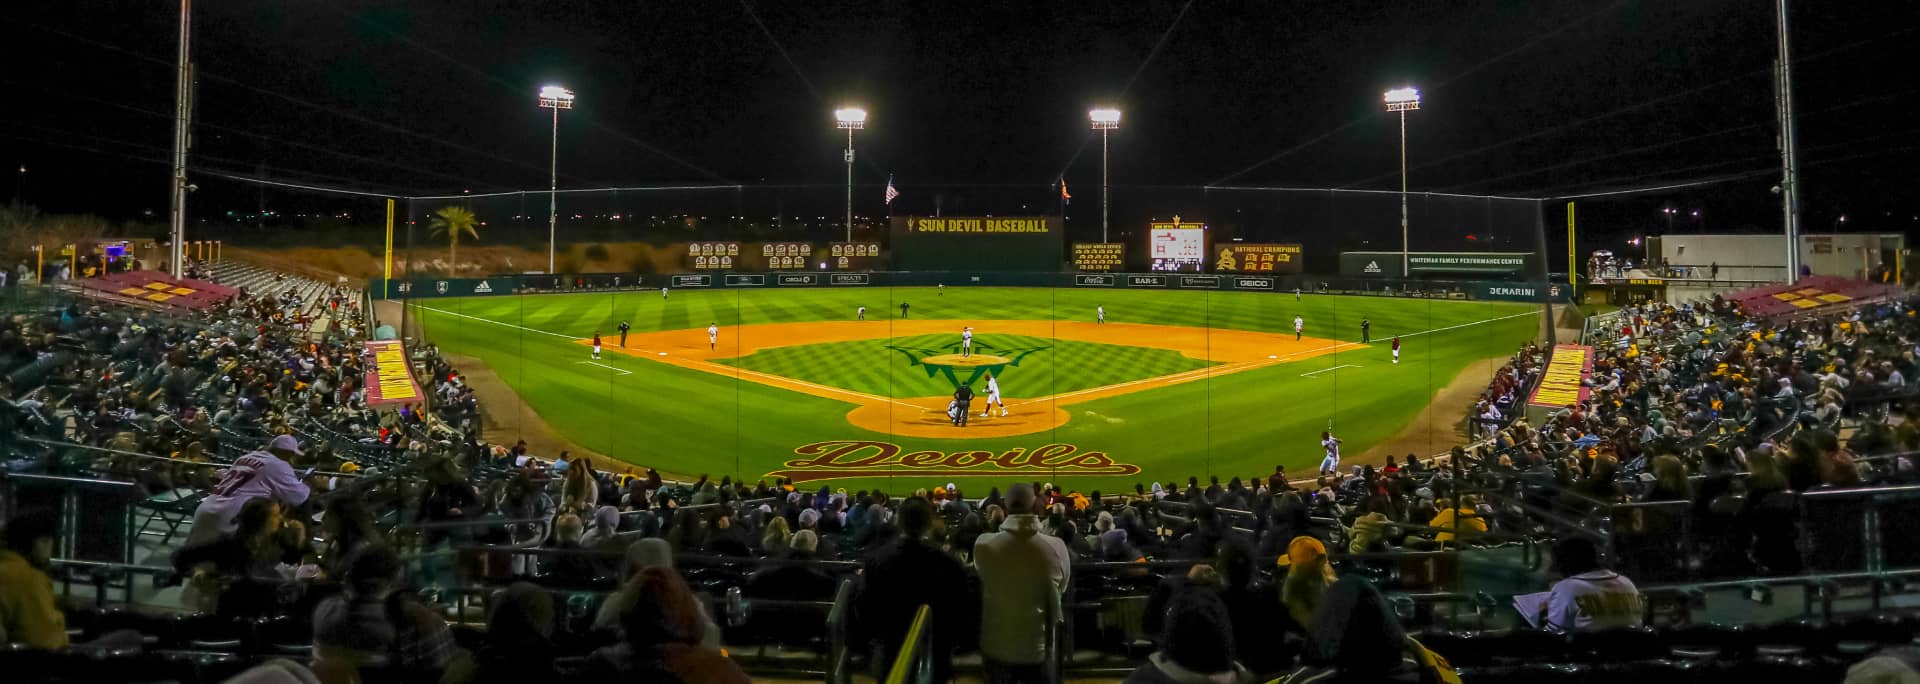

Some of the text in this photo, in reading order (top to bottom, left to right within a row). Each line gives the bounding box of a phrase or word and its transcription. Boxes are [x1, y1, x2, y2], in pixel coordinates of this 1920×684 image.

[918, 219, 1049, 233] SUN DEVIL BASEBALL
[1263, 246, 1301, 254] CHAMPIONS
[1489, 287, 1535, 297] DEMARINI
[777, 440, 1138, 475] Devils
